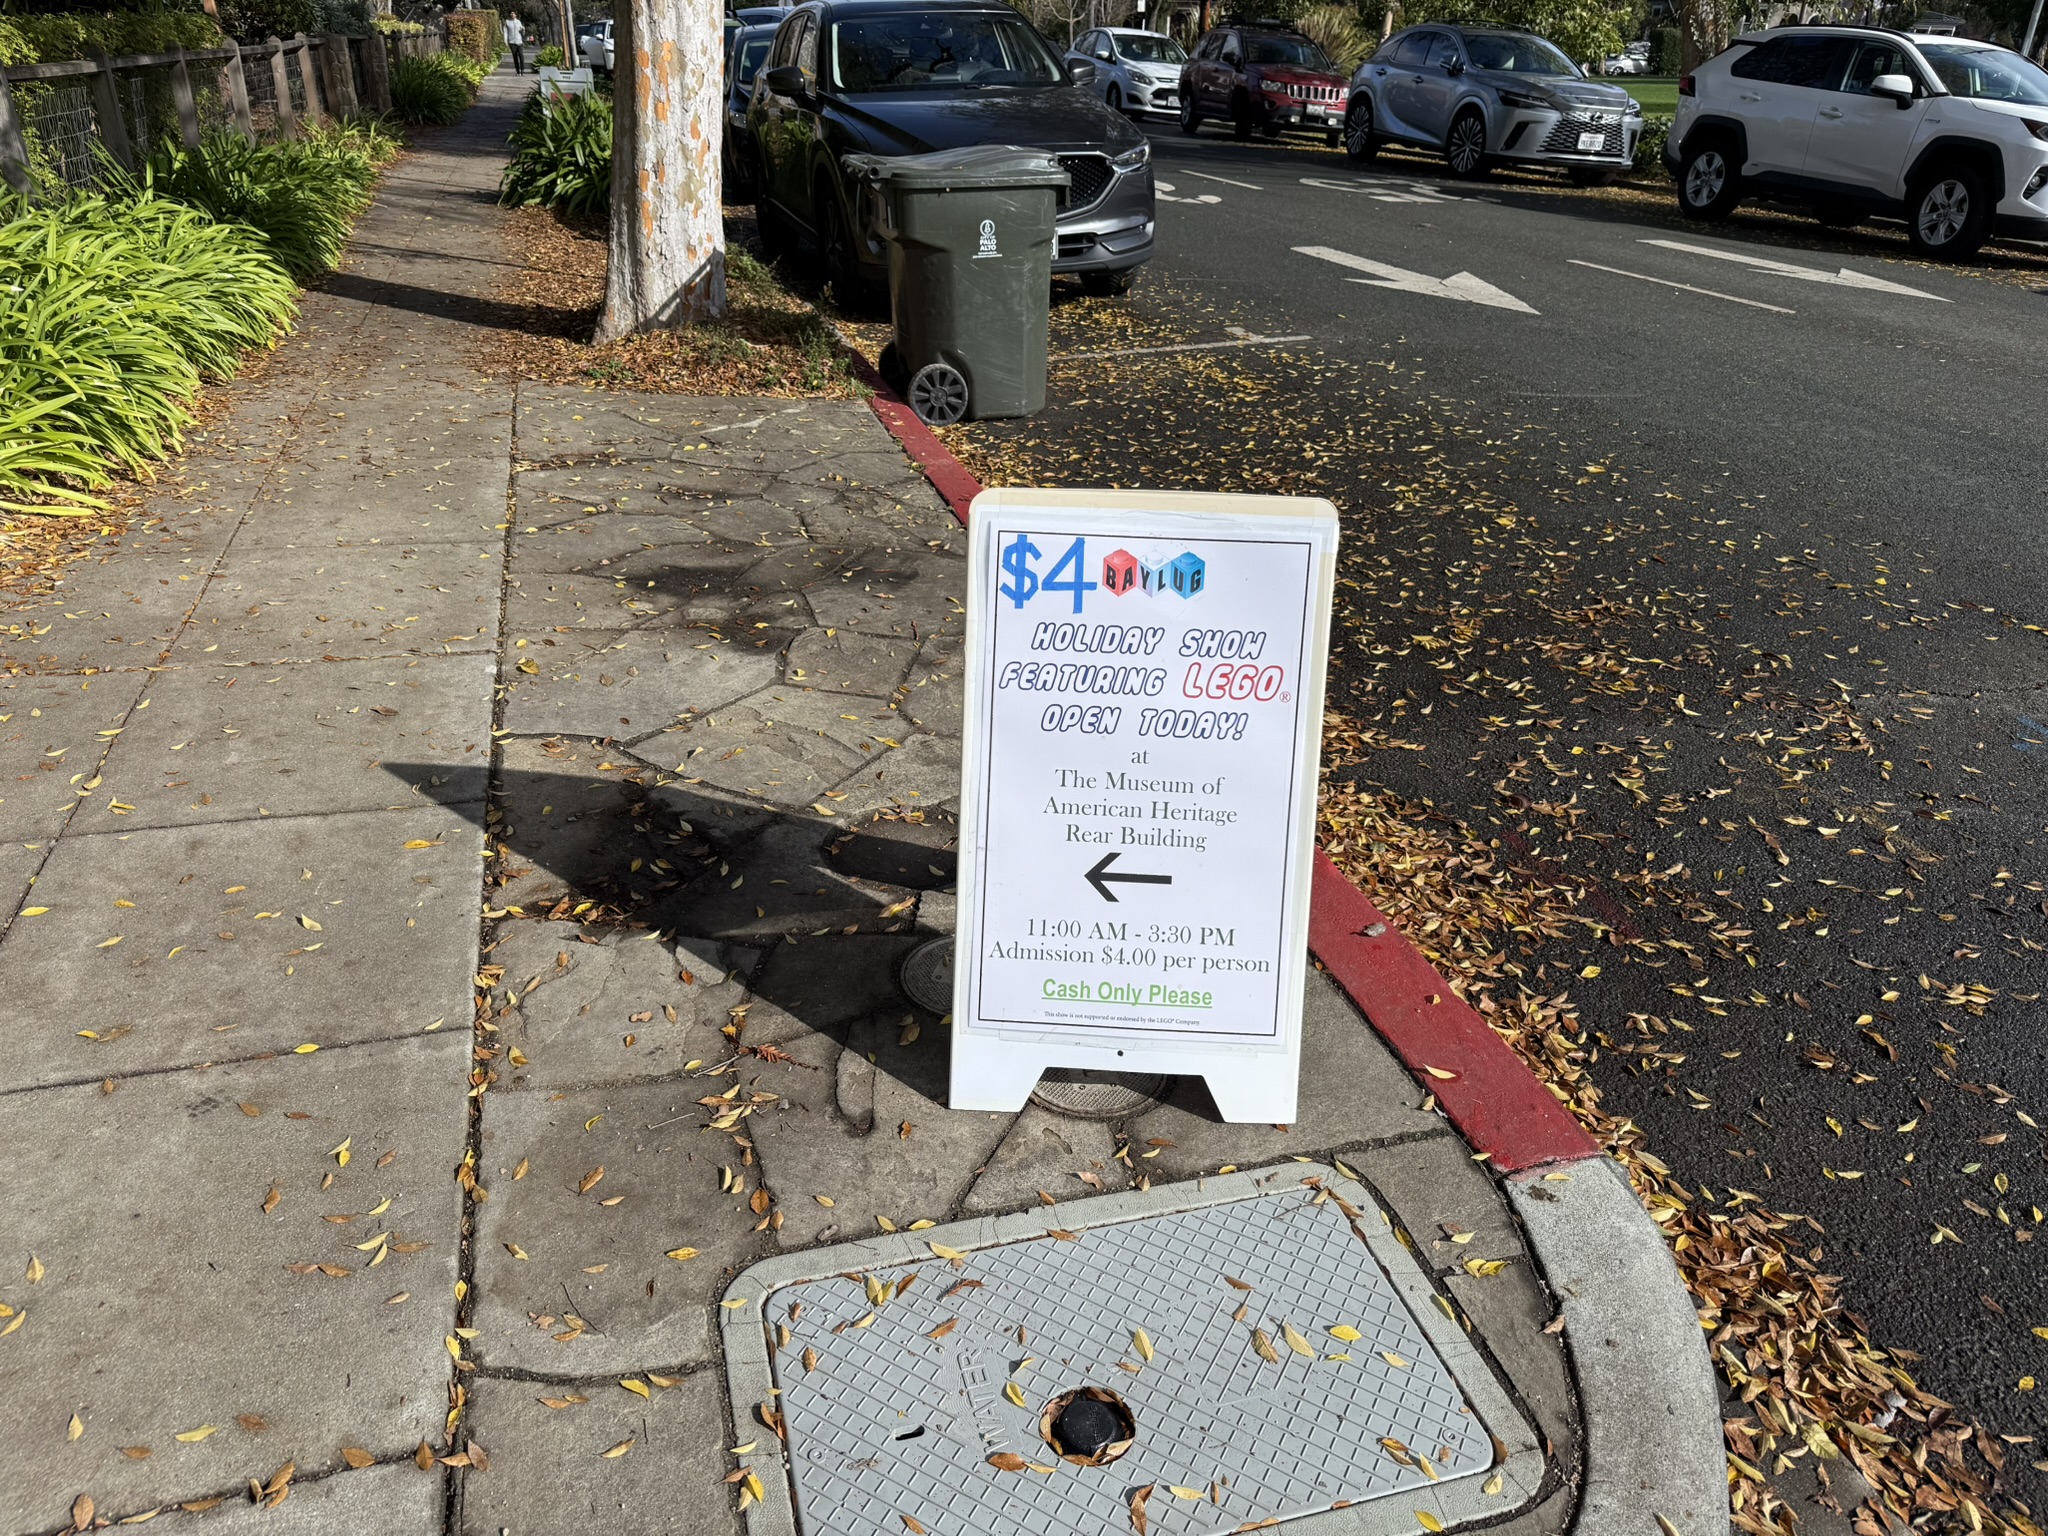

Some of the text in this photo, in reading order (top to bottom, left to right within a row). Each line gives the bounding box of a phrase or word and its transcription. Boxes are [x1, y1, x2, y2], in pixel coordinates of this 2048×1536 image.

[1000, 534, 1098, 614] $4
[1105, 564, 1202, 593] BAYLUG
[1031, 622, 1267, 660] HOLIDAY SHOW
[999, 661, 1167, 696] FEATURING
[1041, 704, 1249, 741] OPEN TODAY!
[1131, 750, 1149, 764] at
[1055, 769, 1225, 794] The Museum of
[1043, 797, 1237, 826] American Heritage
[1066, 824, 1208, 852] Rear Building
[1029, 919, 1081, 938] 11:00
[1088, 922, 1127, 940] AM
[1148, 925, 1191, 944] 3:30
[1200, 927, 1235, 946] PM
[989, 941, 1269, 973] Admission $4.00 per person
[1042, 978, 1213, 1006] Cash Only Please
[1084, 1013, 1109, 1021] supported
[1140, 1016, 1147, 1024] by
[957, 1348, 1012, 1453] WATER
